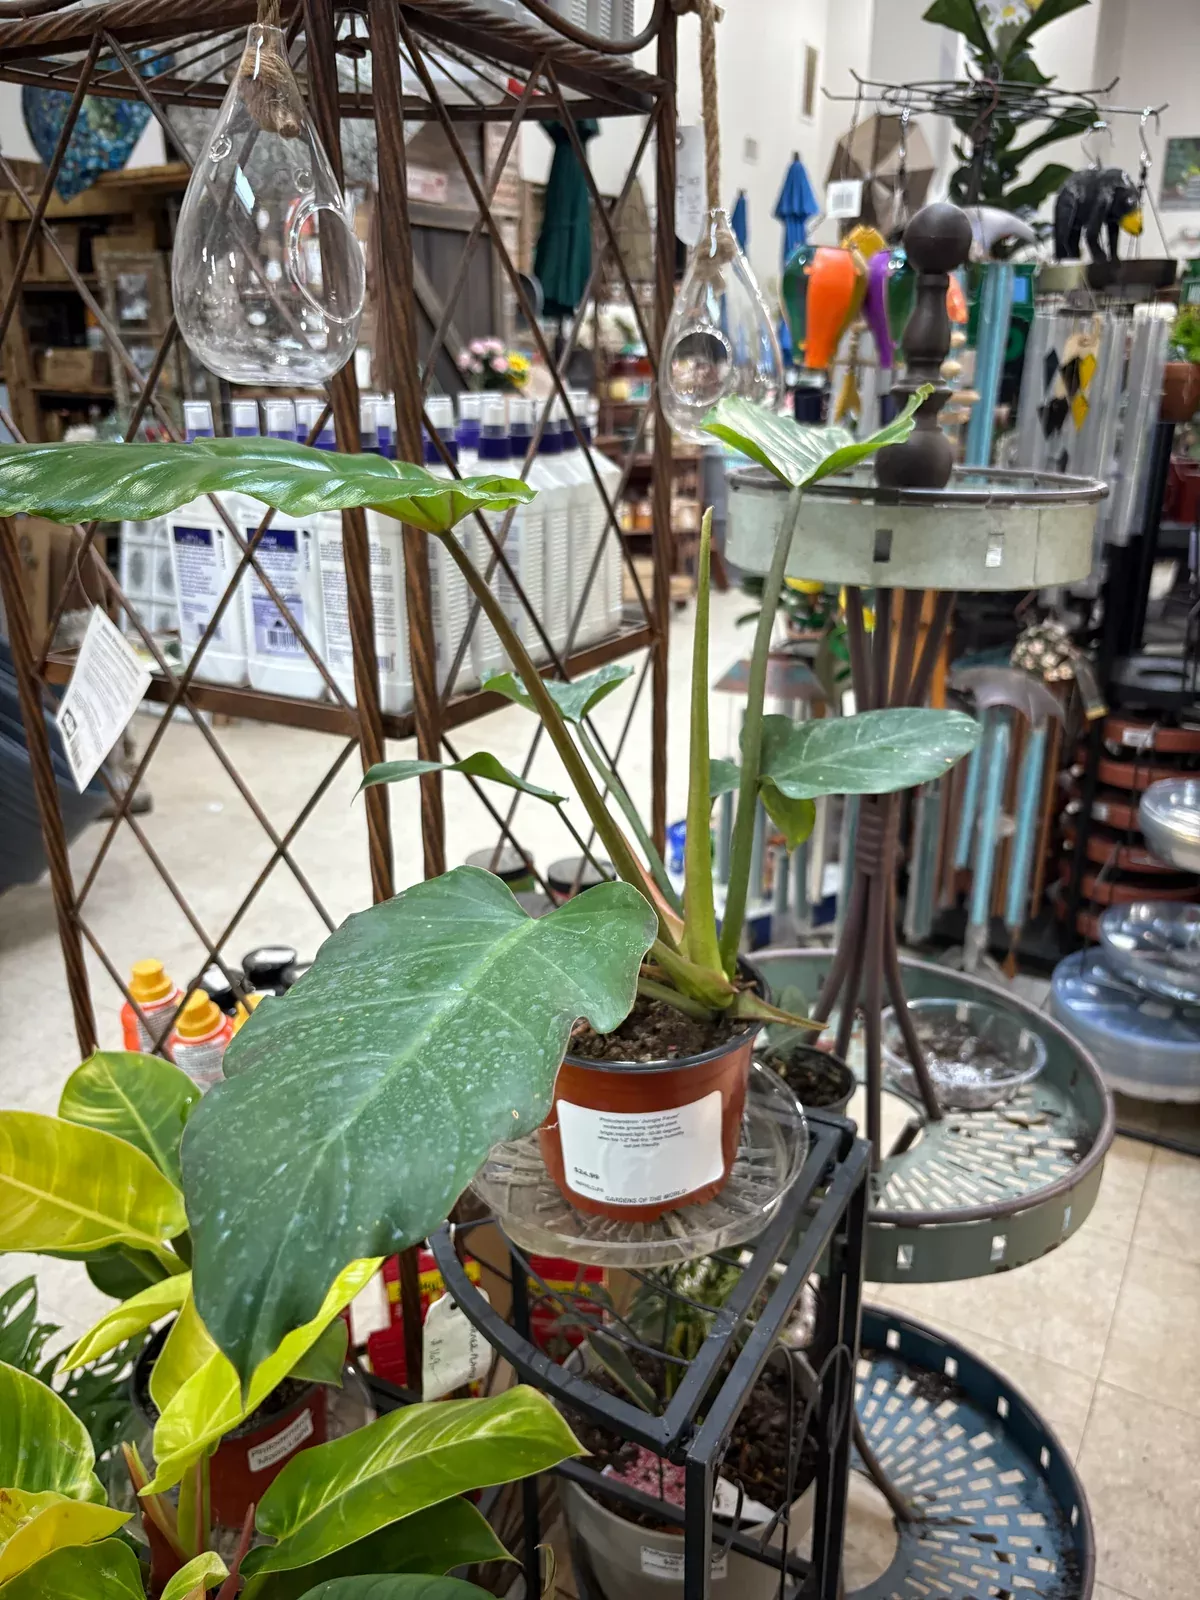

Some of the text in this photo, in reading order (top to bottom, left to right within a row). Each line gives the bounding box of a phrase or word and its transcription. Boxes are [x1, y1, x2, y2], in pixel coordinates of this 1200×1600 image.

[573, 1166, 600, 1180] $24.99
[604, 1195, 637, 1203] GARDENS
[663, 1188, 687, 1199] WORLD
